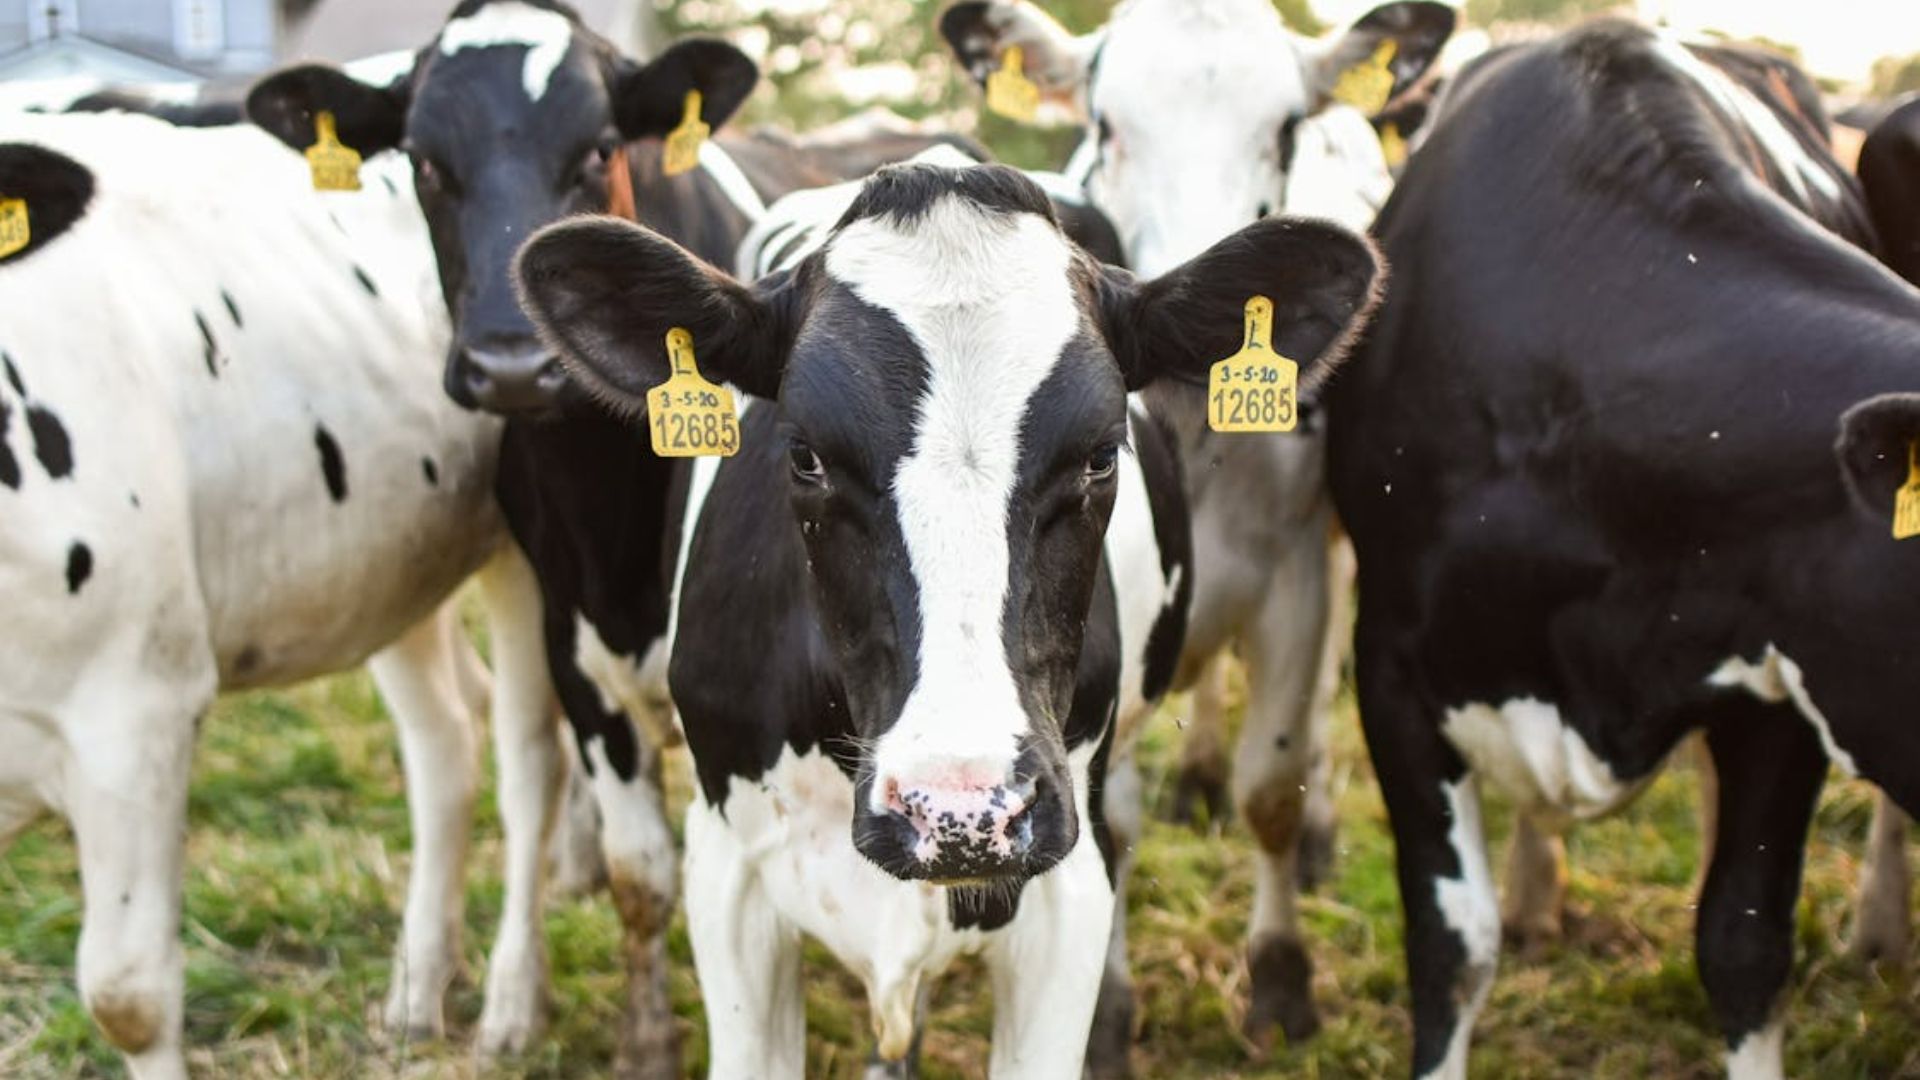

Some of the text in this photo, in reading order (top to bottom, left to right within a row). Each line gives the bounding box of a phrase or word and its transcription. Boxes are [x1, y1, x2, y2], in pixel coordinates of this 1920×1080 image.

[1247, 319, 1263, 348] L
[674, 349, 692, 375] L
[1213, 387, 1293, 424] 12685
[656, 413, 737, 448] 12685
